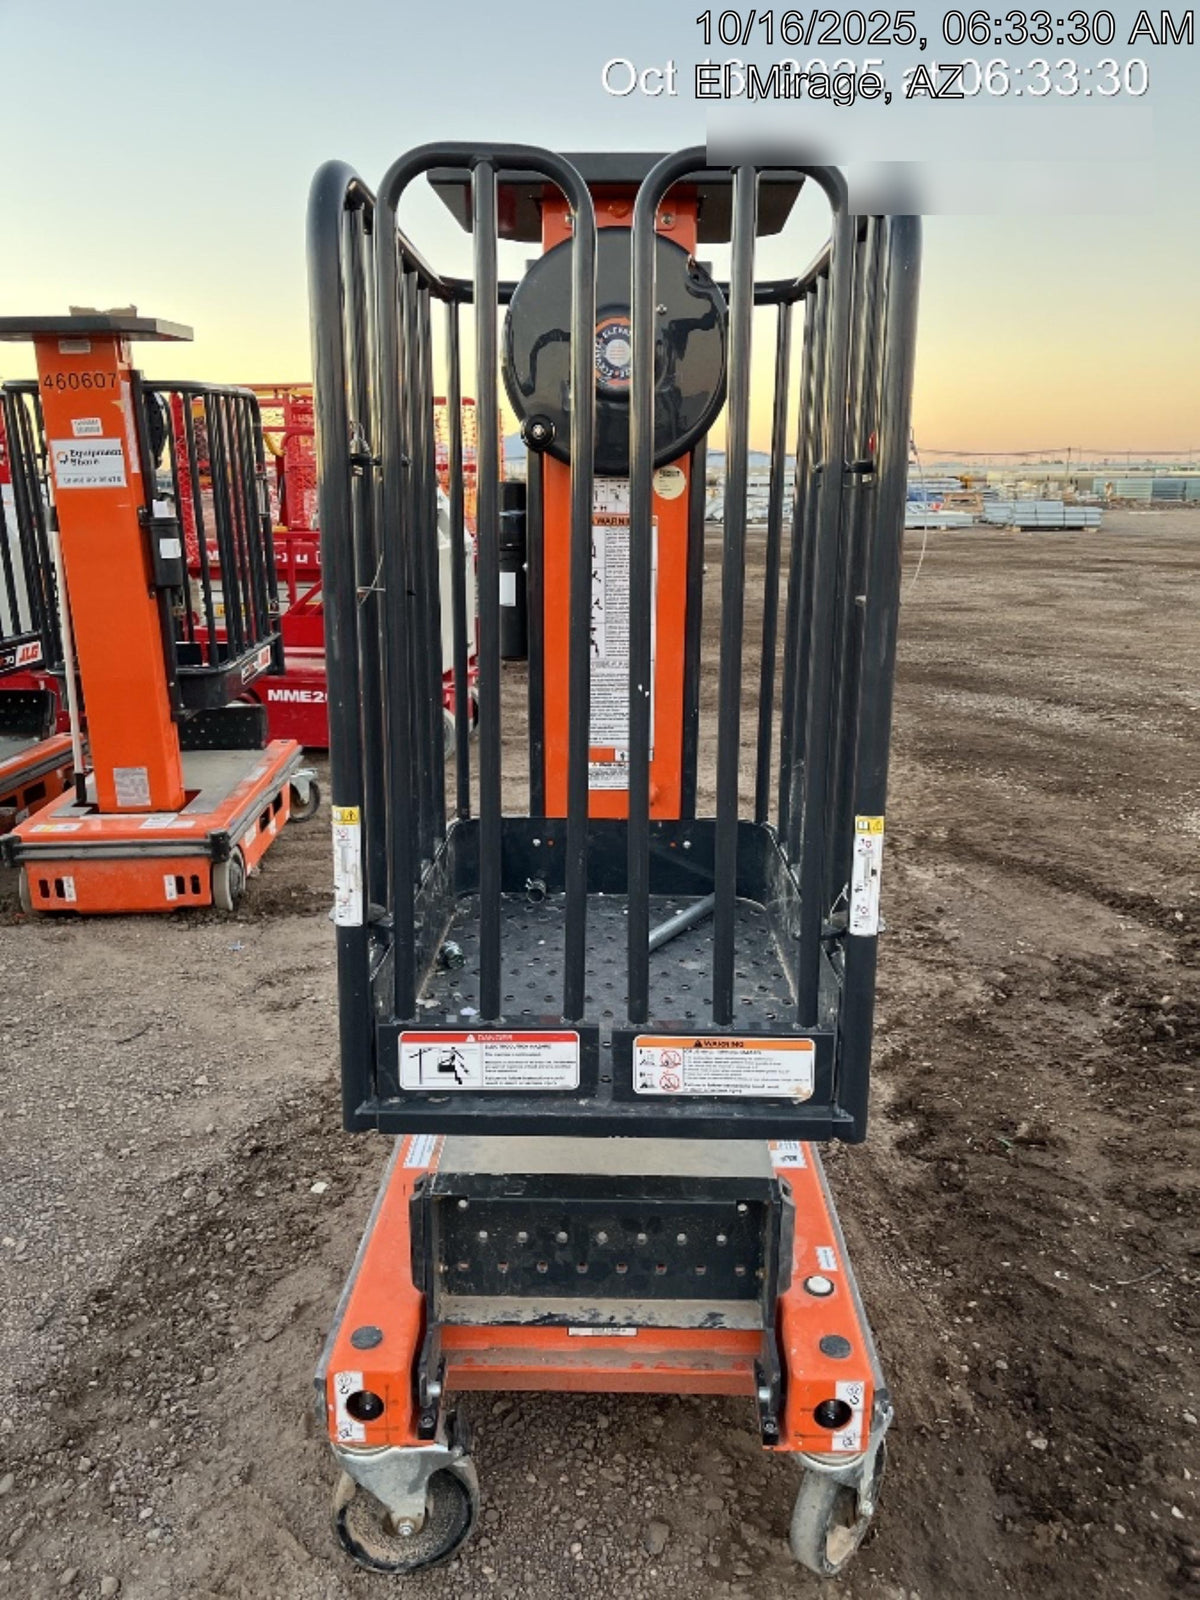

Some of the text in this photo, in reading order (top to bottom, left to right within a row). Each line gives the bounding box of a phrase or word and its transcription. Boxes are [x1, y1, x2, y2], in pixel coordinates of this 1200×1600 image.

[43, 372, 117, 390] 460607
[19, 643, 39, 663] JLG
[267, 689, 327, 703] MME2
